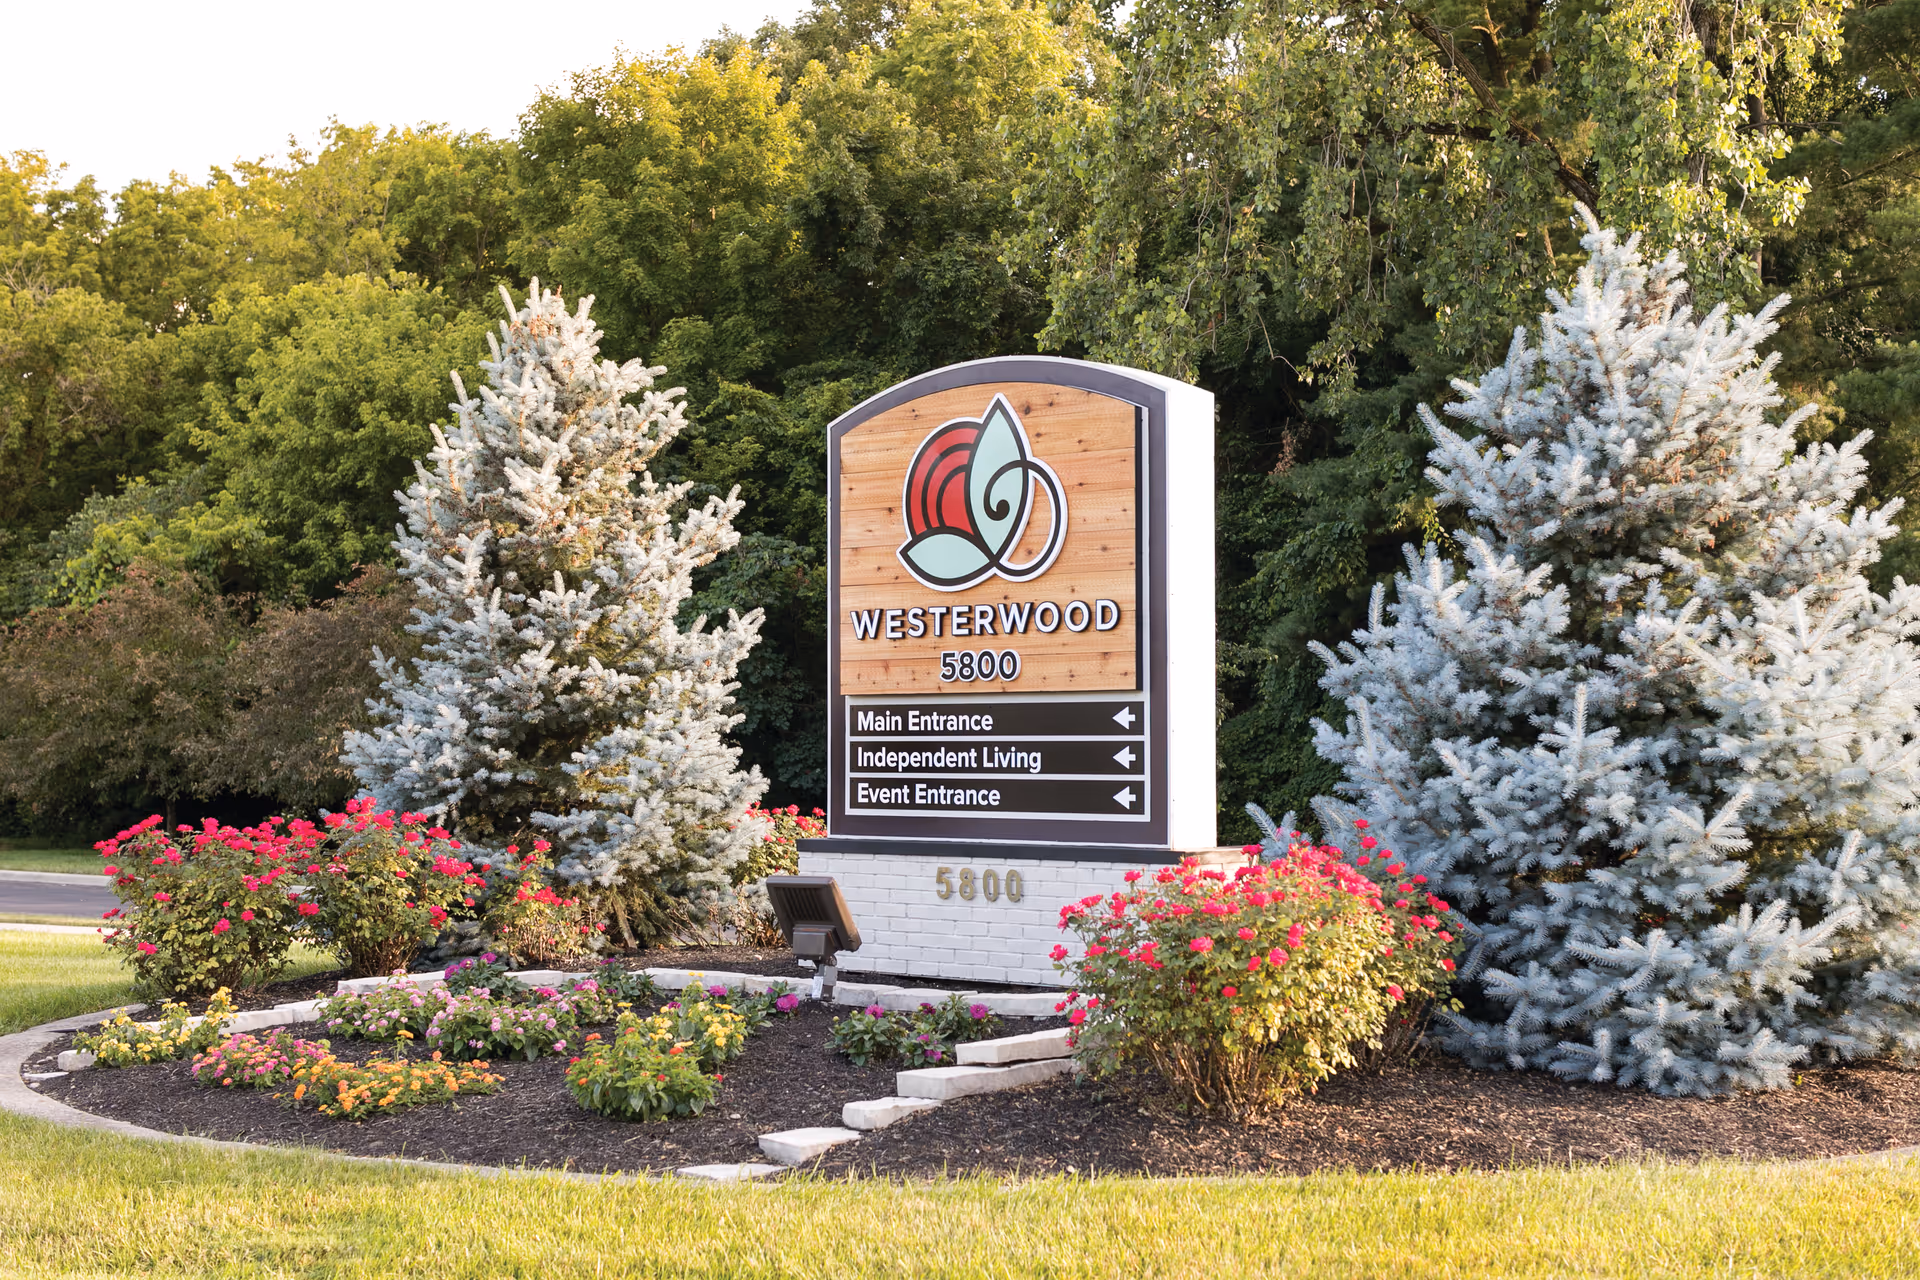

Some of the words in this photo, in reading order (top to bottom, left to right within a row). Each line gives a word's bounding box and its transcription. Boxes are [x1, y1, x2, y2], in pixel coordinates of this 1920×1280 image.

[850, 599, 1120, 640] WESTERWOOD
[939, 648, 1021, 682] 5800
[857, 710, 902, 732] Main
[908, 710, 993, 732] Entrance
[857, 746, 977, 772] Independent
[982, 747, 1042, 773] Living
[857, 783, 909, 805] Event
[914, 785, 1000, 806] Entrance
[935, 866, 1023, 902] 5800
